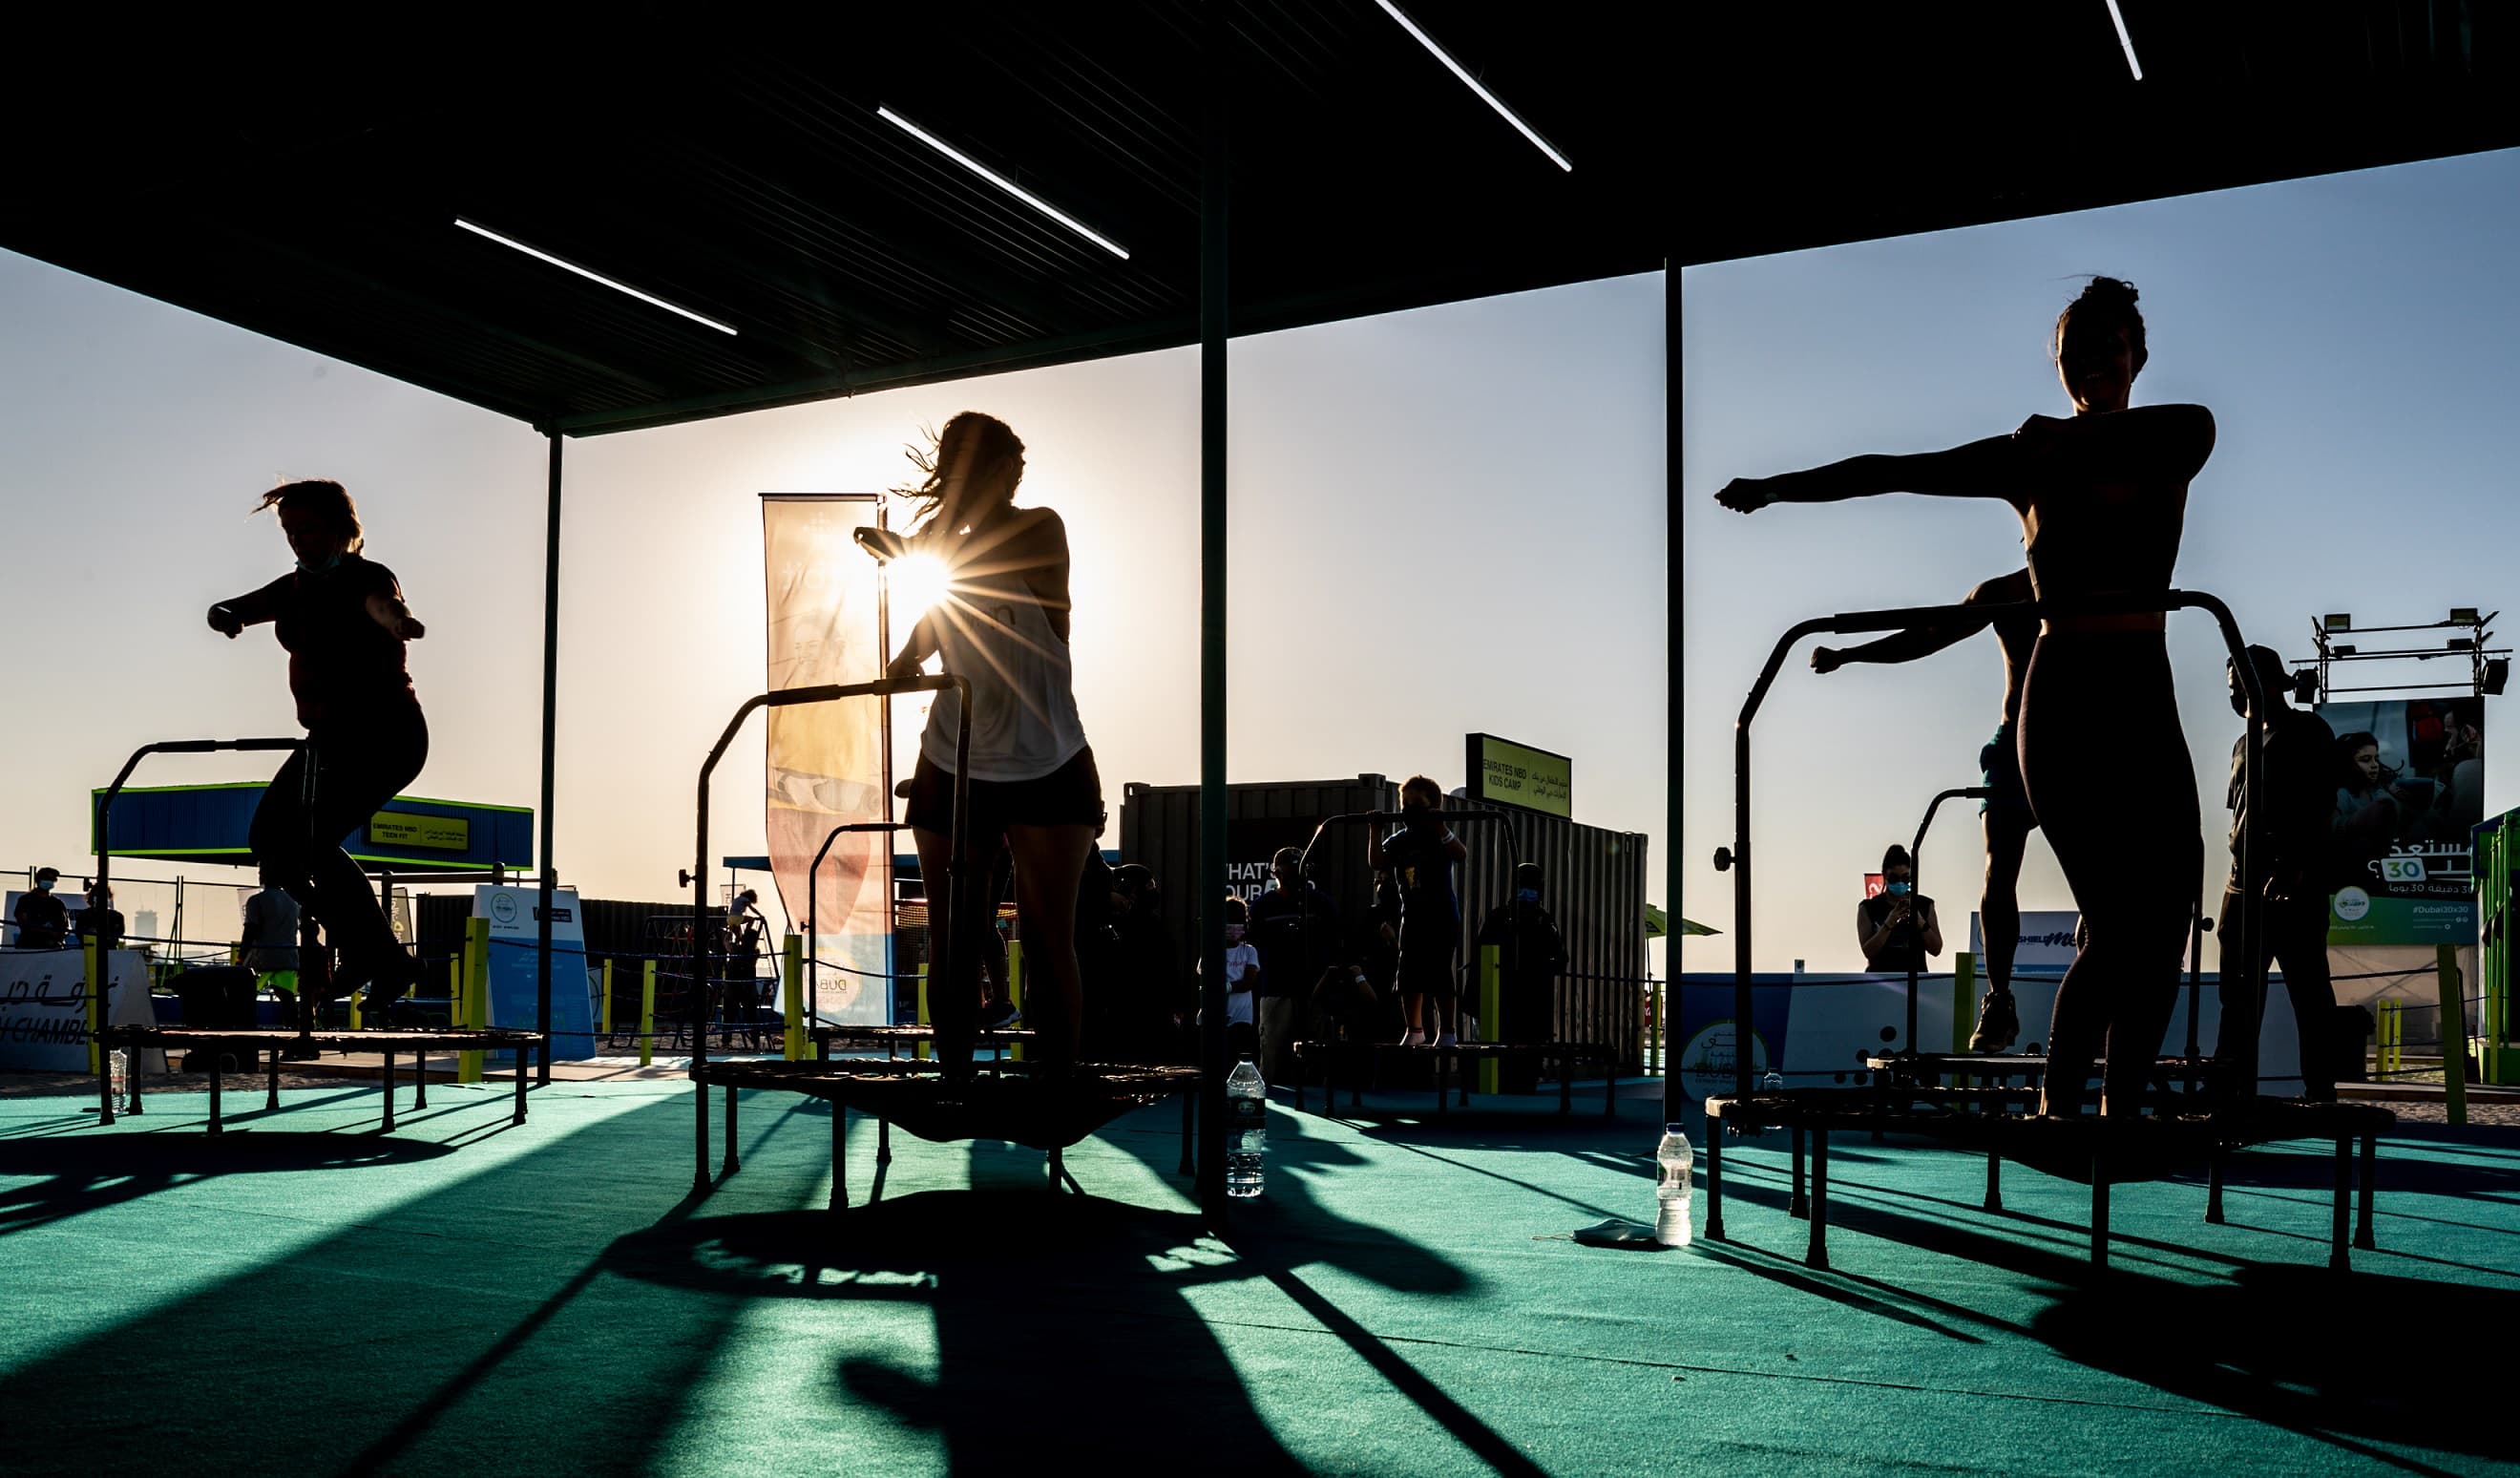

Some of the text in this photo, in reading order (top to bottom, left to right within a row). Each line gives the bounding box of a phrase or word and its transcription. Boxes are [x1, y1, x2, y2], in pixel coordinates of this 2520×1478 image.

[1482, 759, 1527, 779] EMIRATES NBD
[1489, 773, 1522, 791] KIDS CAMP
[2387, 861, 2420, 878] 30
[12, 1017, 89, 1045] CHAMBE
